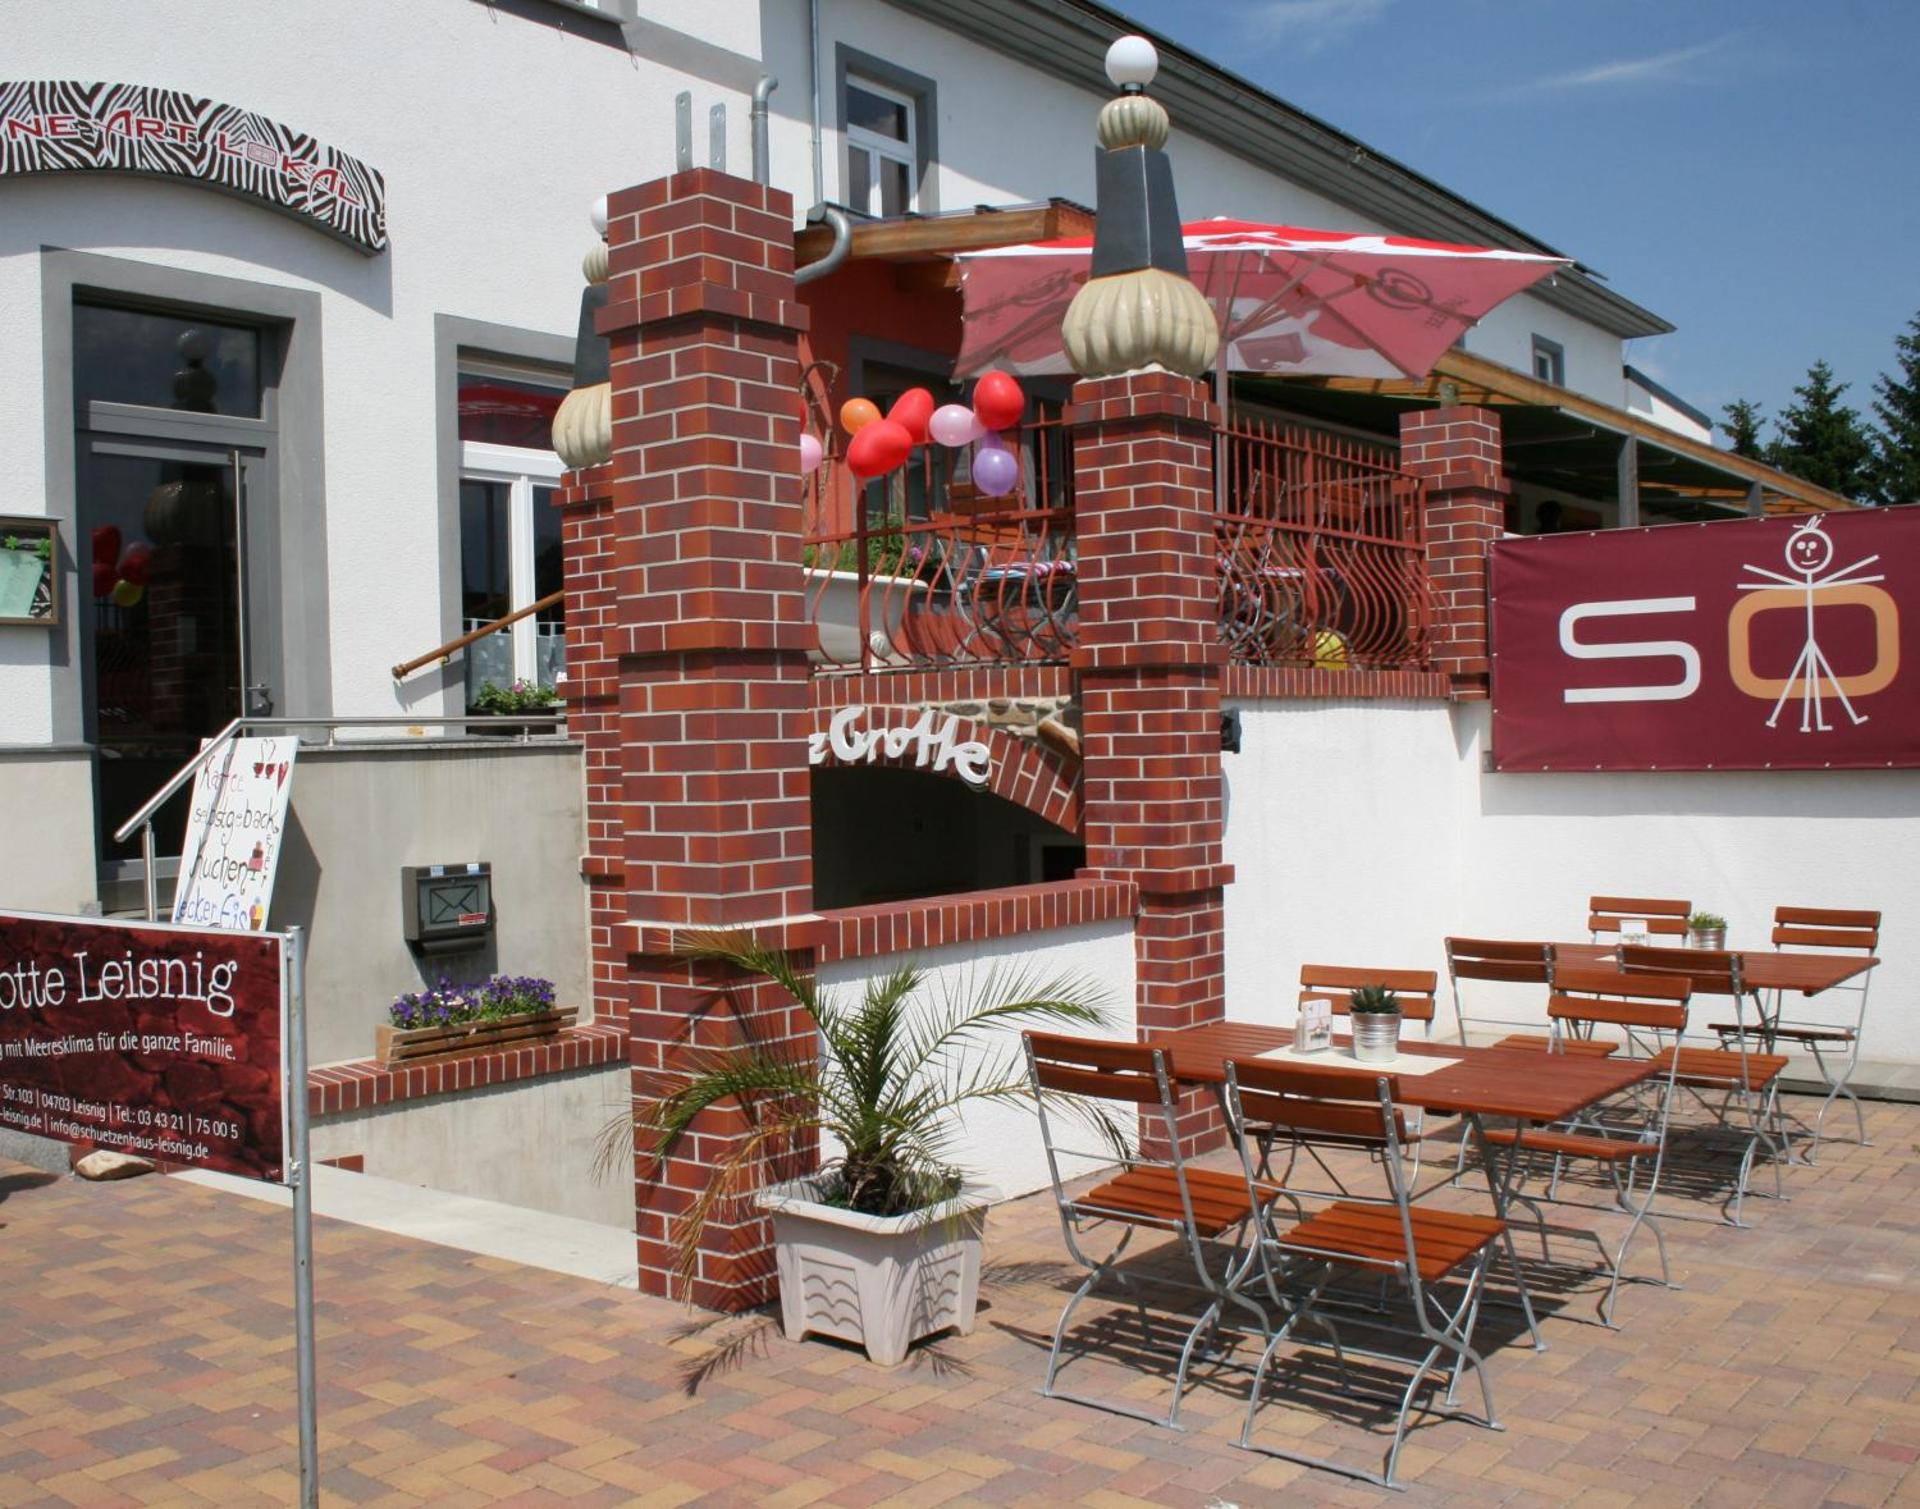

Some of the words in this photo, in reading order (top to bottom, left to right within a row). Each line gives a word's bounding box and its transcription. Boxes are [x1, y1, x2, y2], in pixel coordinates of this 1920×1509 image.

[0, 960, 65, 1009] otte
[73, 950, 238, 1017] Leisnig
[5, 1039, 23, 1057] mit
[25, 1034, 94, 1056] Meeresklima
[97, 1032, 116, 1052] für
[119, 1031, 138, 1051] die
[142, 1034, 181, 1055] ganze
[185, 1032, 236, 1060] Familie.
[41, 1093, 71, 1112] 04703
[73, 1098, 106, 1122] Leisnig
[138, 1109, 152, 1126] 03
[154, 1112, 168, 1129] 43
[170, 1114, 184, 1130] 21
[195, 1118, 210, 1135] 75
[212, 1120, 227, 1138] 00
[231, 1123, 239, 1140] 5
[50, 1117, 210, 1160] info@schuetzenhaus-leisnig.de
